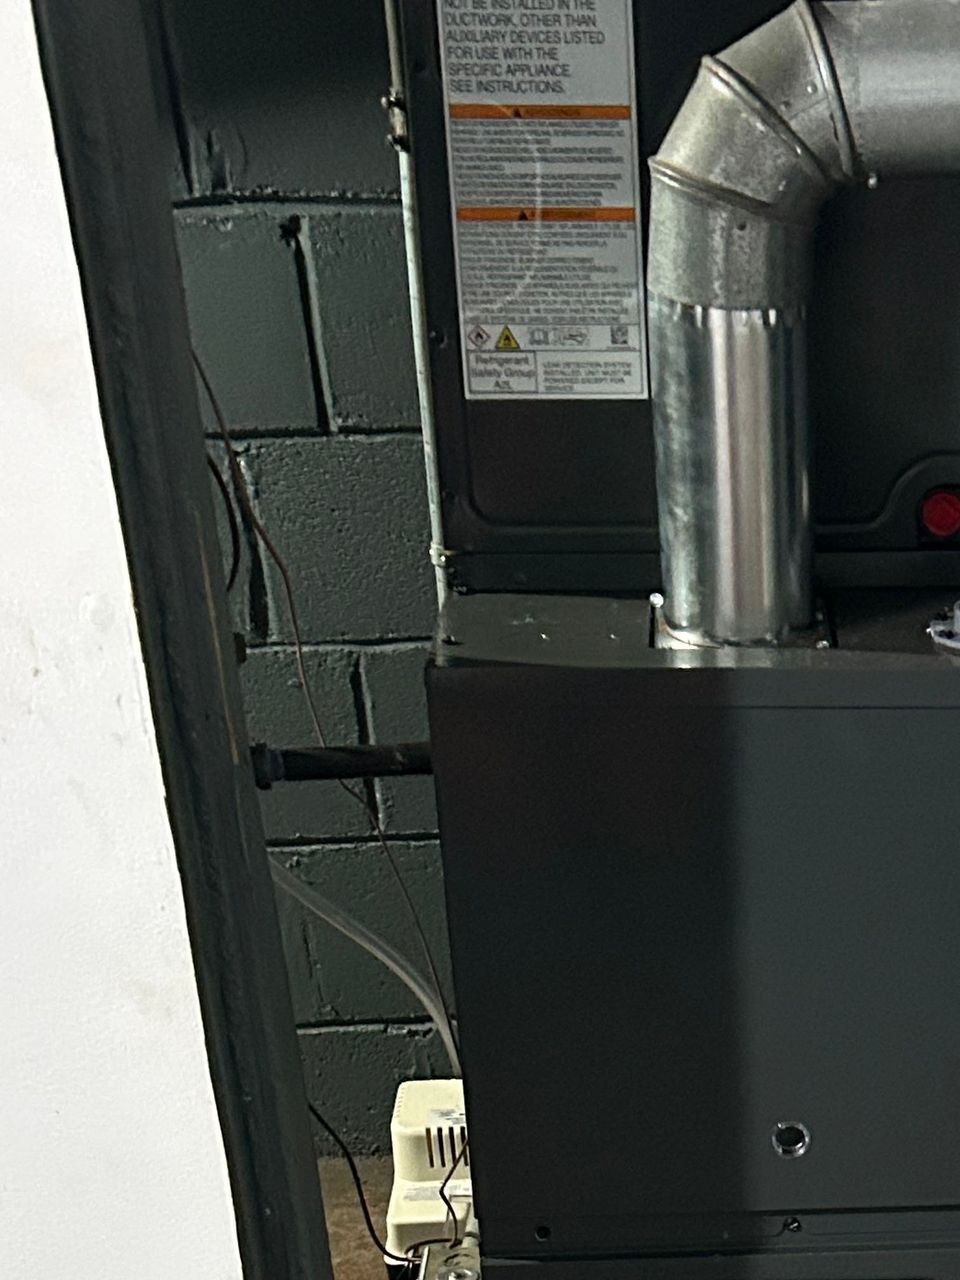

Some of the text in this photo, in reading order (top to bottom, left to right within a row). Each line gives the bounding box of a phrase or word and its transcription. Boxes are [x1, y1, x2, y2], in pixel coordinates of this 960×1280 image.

[520, 13, 562, 27] OTHER
[564, 14, 598, 27] THAN
[446, 29, 606, 45] AUXILIARY DEVICES LISTED
[447, 46, 559, 60] FOR USE WITH THE
[449, 62, 503, 76] SPECIFIC
[450, 79, 473, 93] SEE
